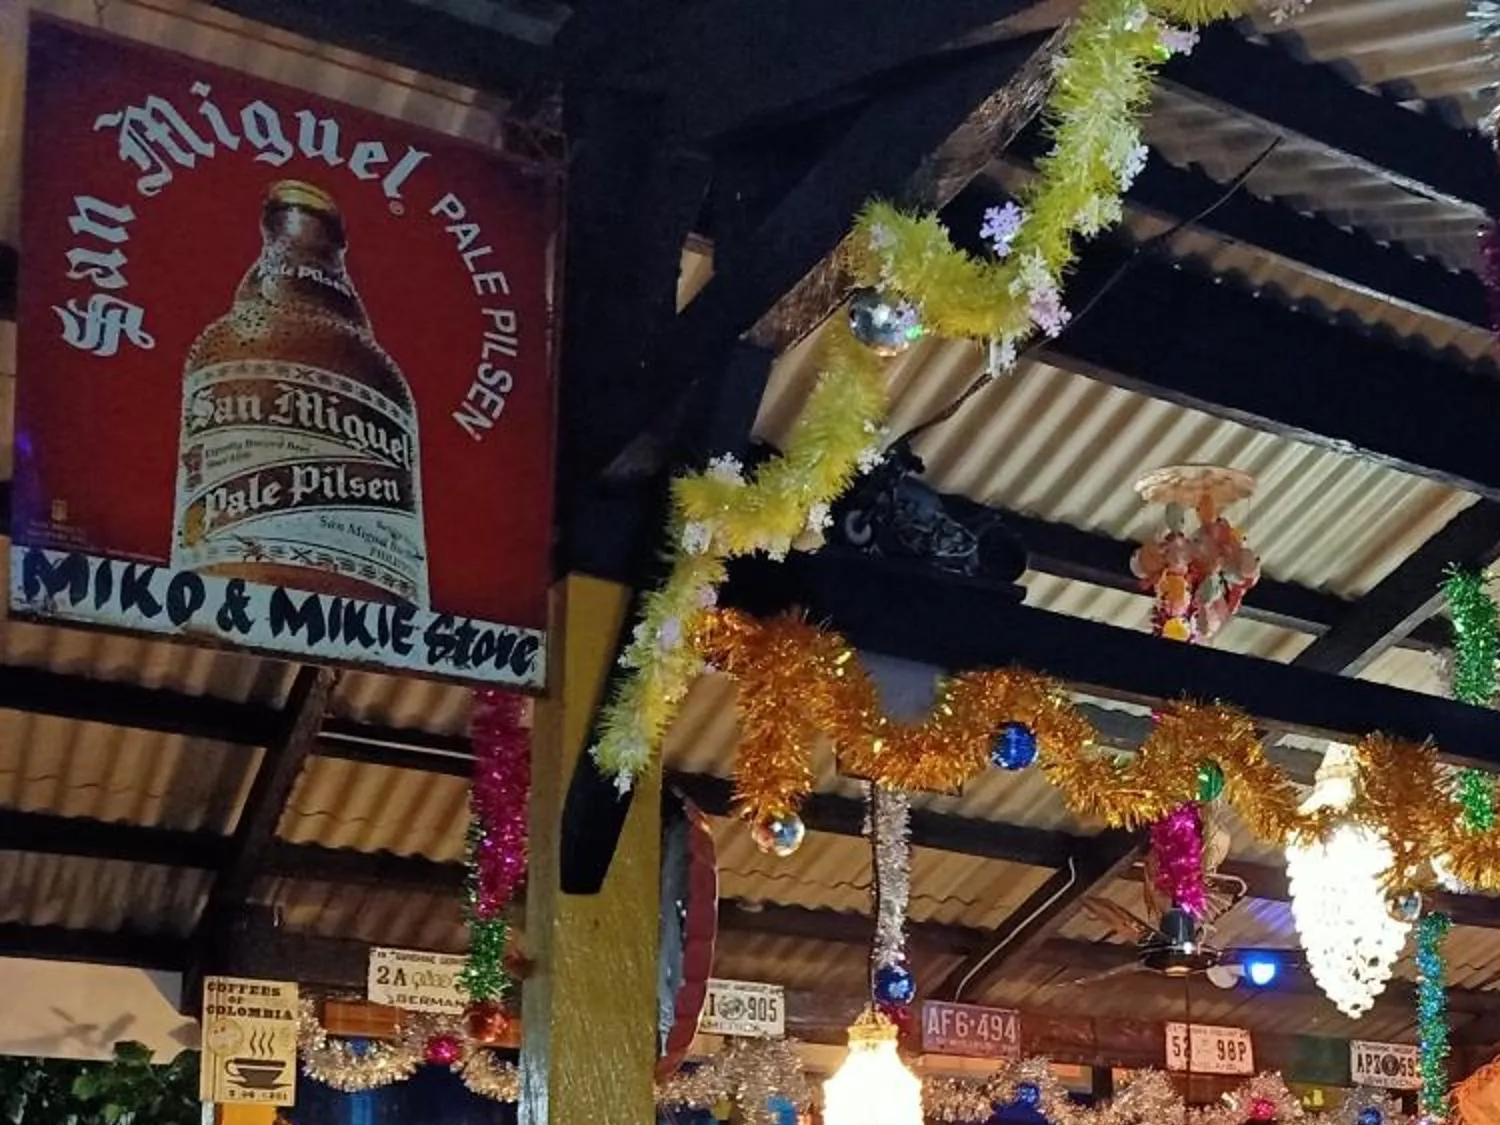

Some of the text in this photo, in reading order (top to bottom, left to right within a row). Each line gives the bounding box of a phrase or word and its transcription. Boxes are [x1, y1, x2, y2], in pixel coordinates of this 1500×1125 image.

[51, 80, 432, 357] San Miguel
[430, 193, 519, 441] PALE PILSEN
[190, 382, 412, 471] San Miguel
[202, 463, 401, 534] Pale Pilsen
[23, 549, 206, 626] MIKO
[216, 577, 254, 635] &
[269, 585, 419, 656] MIKIE
[206, 1004, 293, 1020] COLOMBIA
[747, 996, 777, 1023] 905
